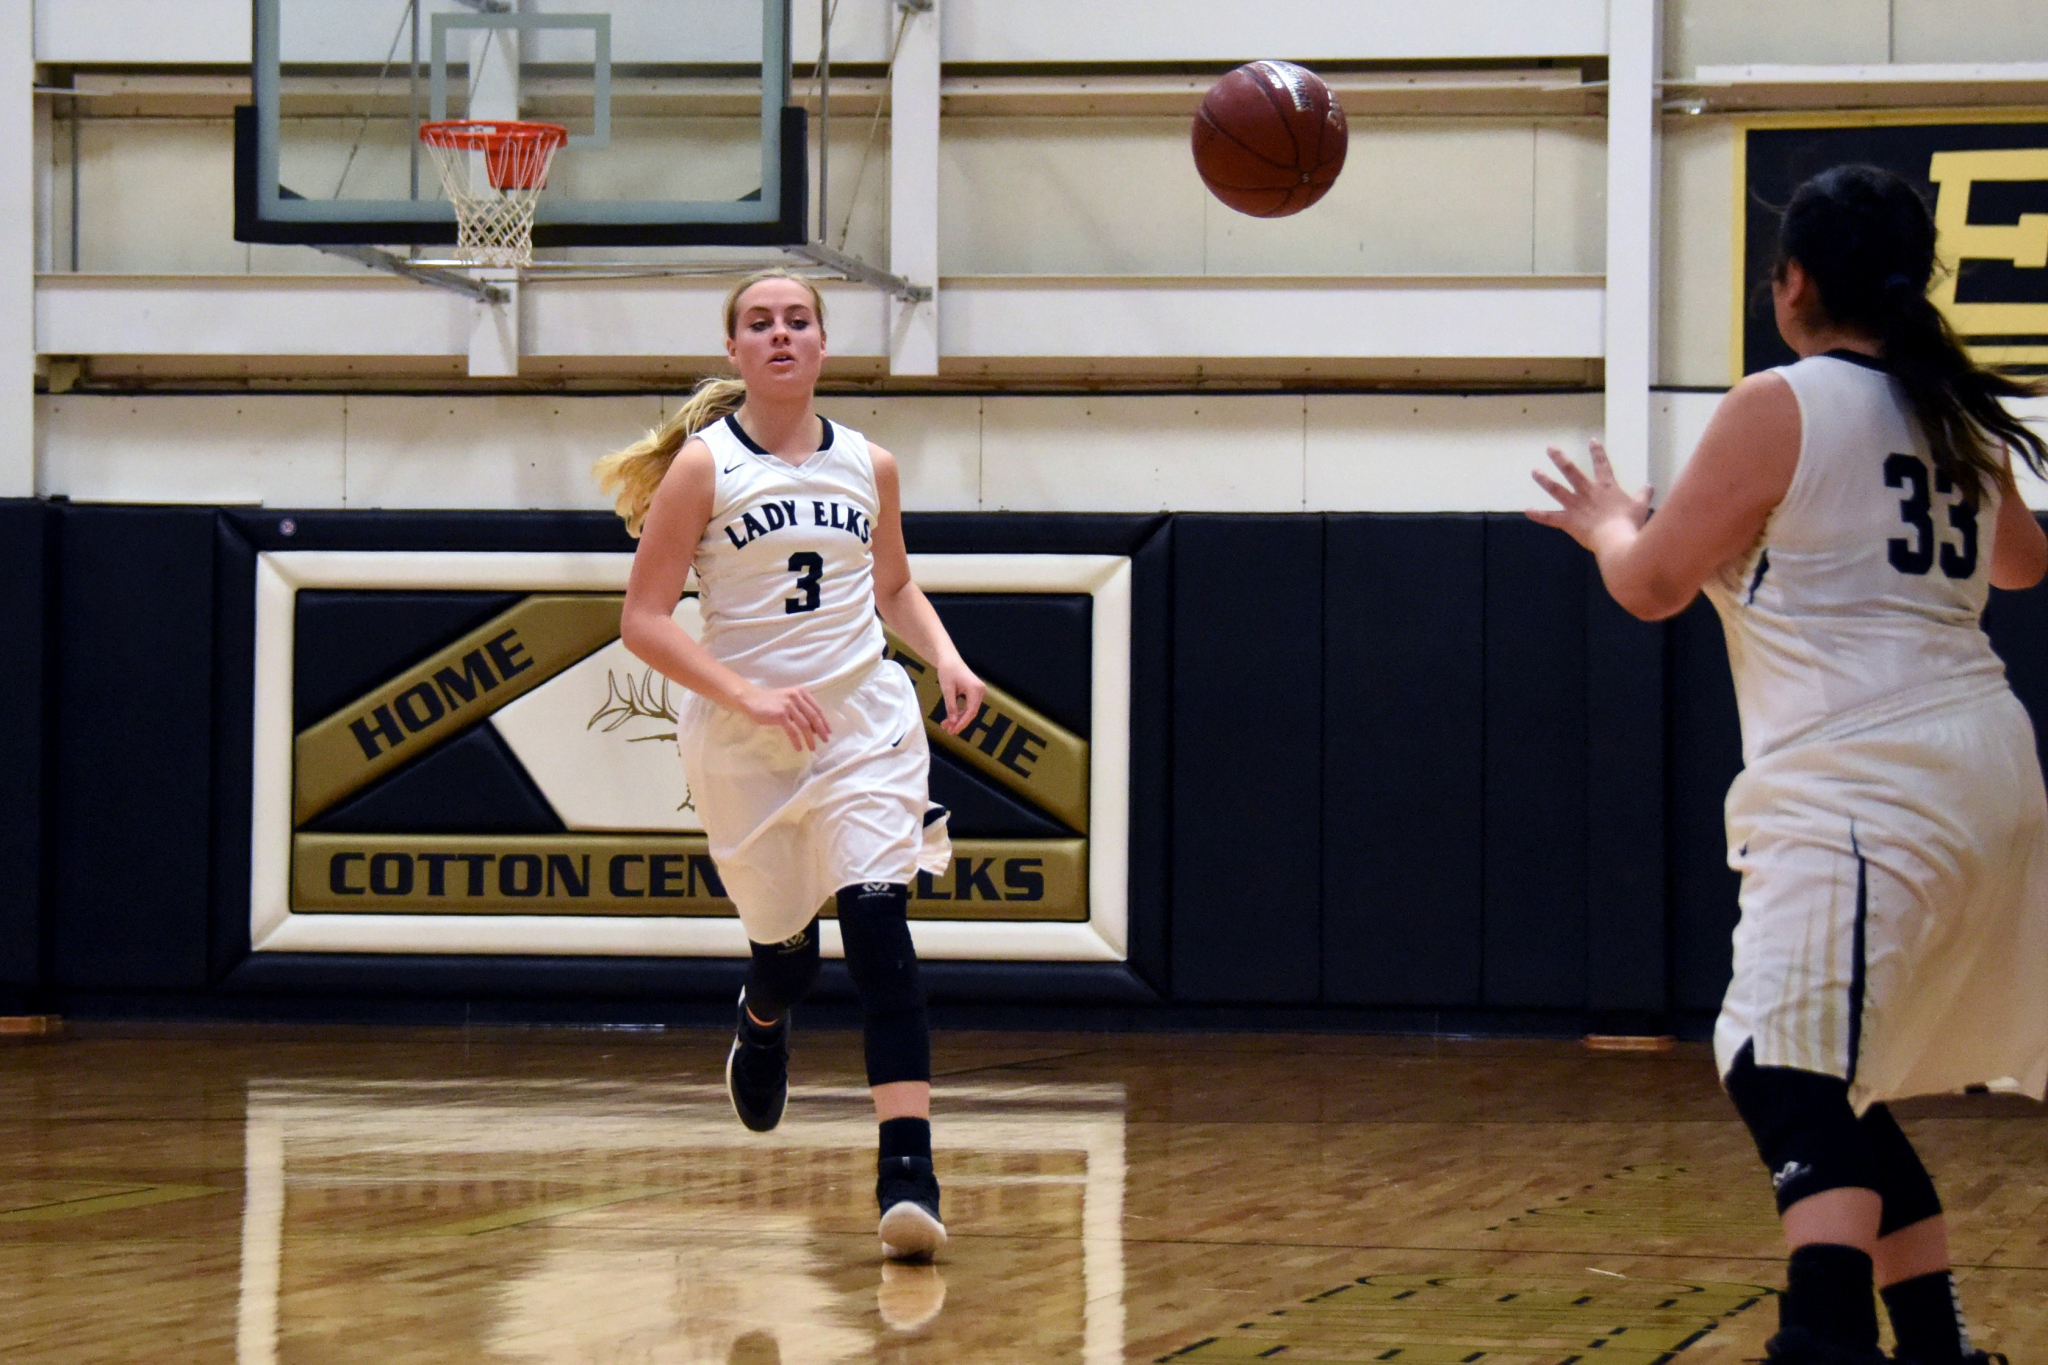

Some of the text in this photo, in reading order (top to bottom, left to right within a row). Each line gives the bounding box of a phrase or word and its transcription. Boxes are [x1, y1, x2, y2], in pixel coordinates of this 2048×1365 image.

[724, 500, 872, 551] LADY ELKS
[1884, 453, 1979, 579] 33
[785, 551, 824, 615] 3
[348, 628, 536, 761] HOME
[329, 852, 591, 898] COTTON
[905, 857, 1045, 902] LKS
